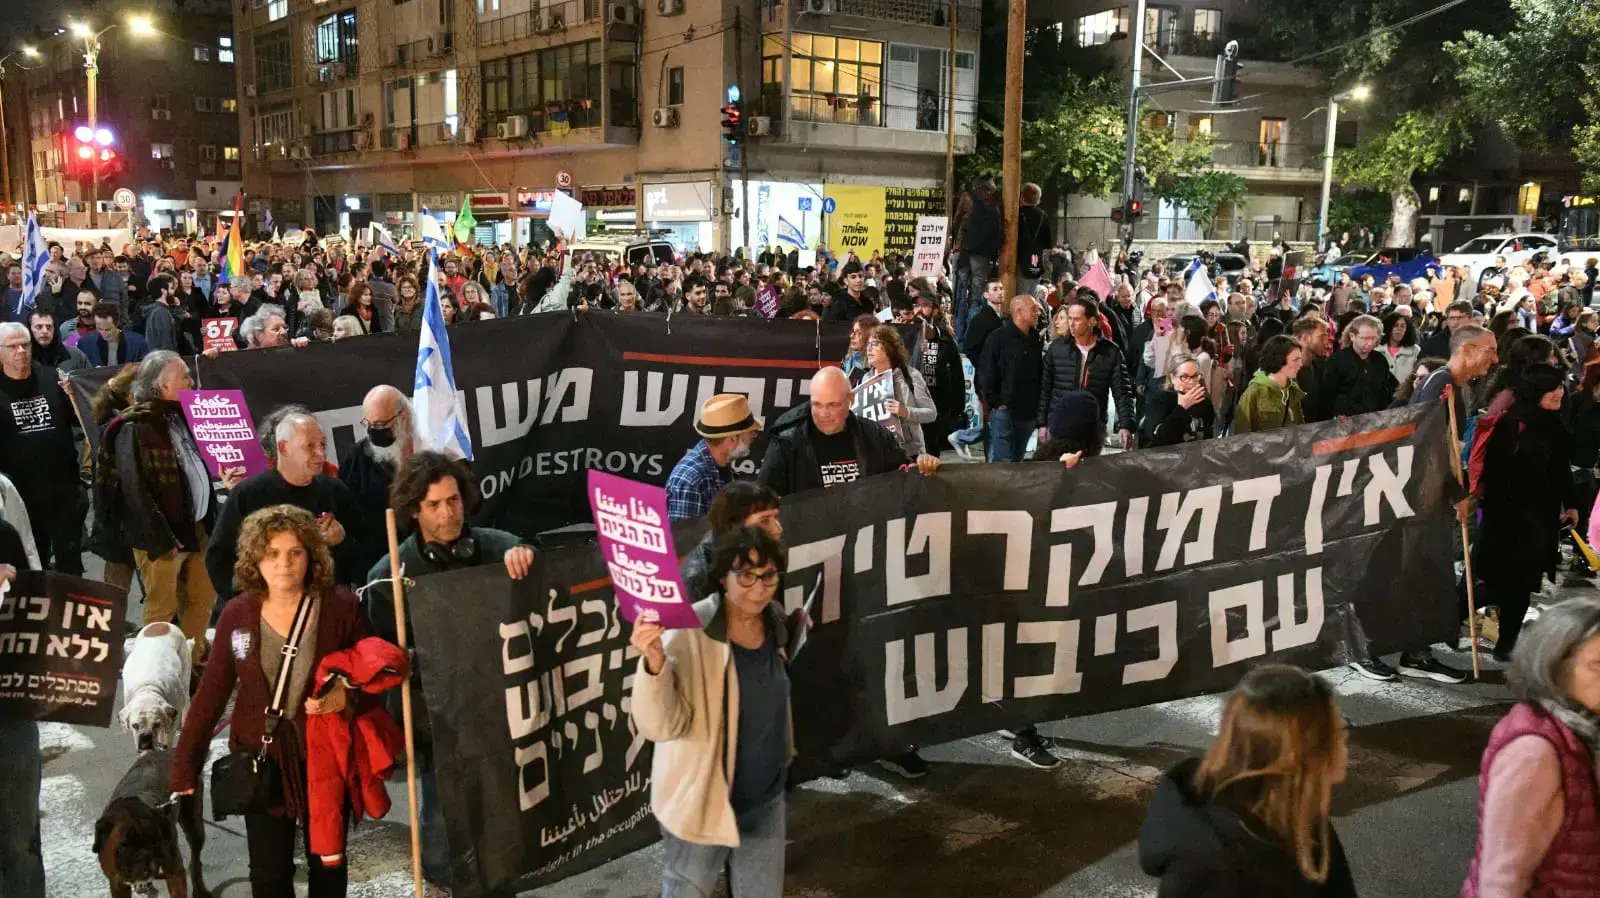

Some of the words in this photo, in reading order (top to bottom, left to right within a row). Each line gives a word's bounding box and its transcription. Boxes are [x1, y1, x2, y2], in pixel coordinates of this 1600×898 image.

[559, 174, 570, 184] 30
[120, 194, 131, 204] 30
[934, 224, 944, 232] אין
[841, 235, 869, 247] NOW
[920, 236, 942, 245] מנדט
[917, 251, 940, 260] למדינת
[921, 262, 934, 271] דת
[206, 320, 234, 338] 67
[192, 405, 237, 416] ממשלת
[196, 430, 251, 439] המתנחלים
[217, 452, 241, 460] נגדי
[519, 447, 664, 480] DESTROYS
[629, 497, 662, 526] هذا
[1305, 445, 1415, 554] אין
[602, 517, 639, 542] הבית
[642, 529, 661, 548] זה
[784, 475, 1282, 622] דמוקרטיה
[647, 577, 675, 599] של
[62, 601, 112, 632] אין
[1208, 567, 1323, 668] עם
[499, 588, 620, 676] כלים
[46, 634, 109, 662] ללא
[885, 599, 1178, 726] כיבוש
[28, 671, 100, 695] מסתכלים
[504, 646, 642, 740] יבוש
[515, 695, 652, 812] עיניים
[572, 843, 584, 858] in
[585, 833, 605, 851] the
